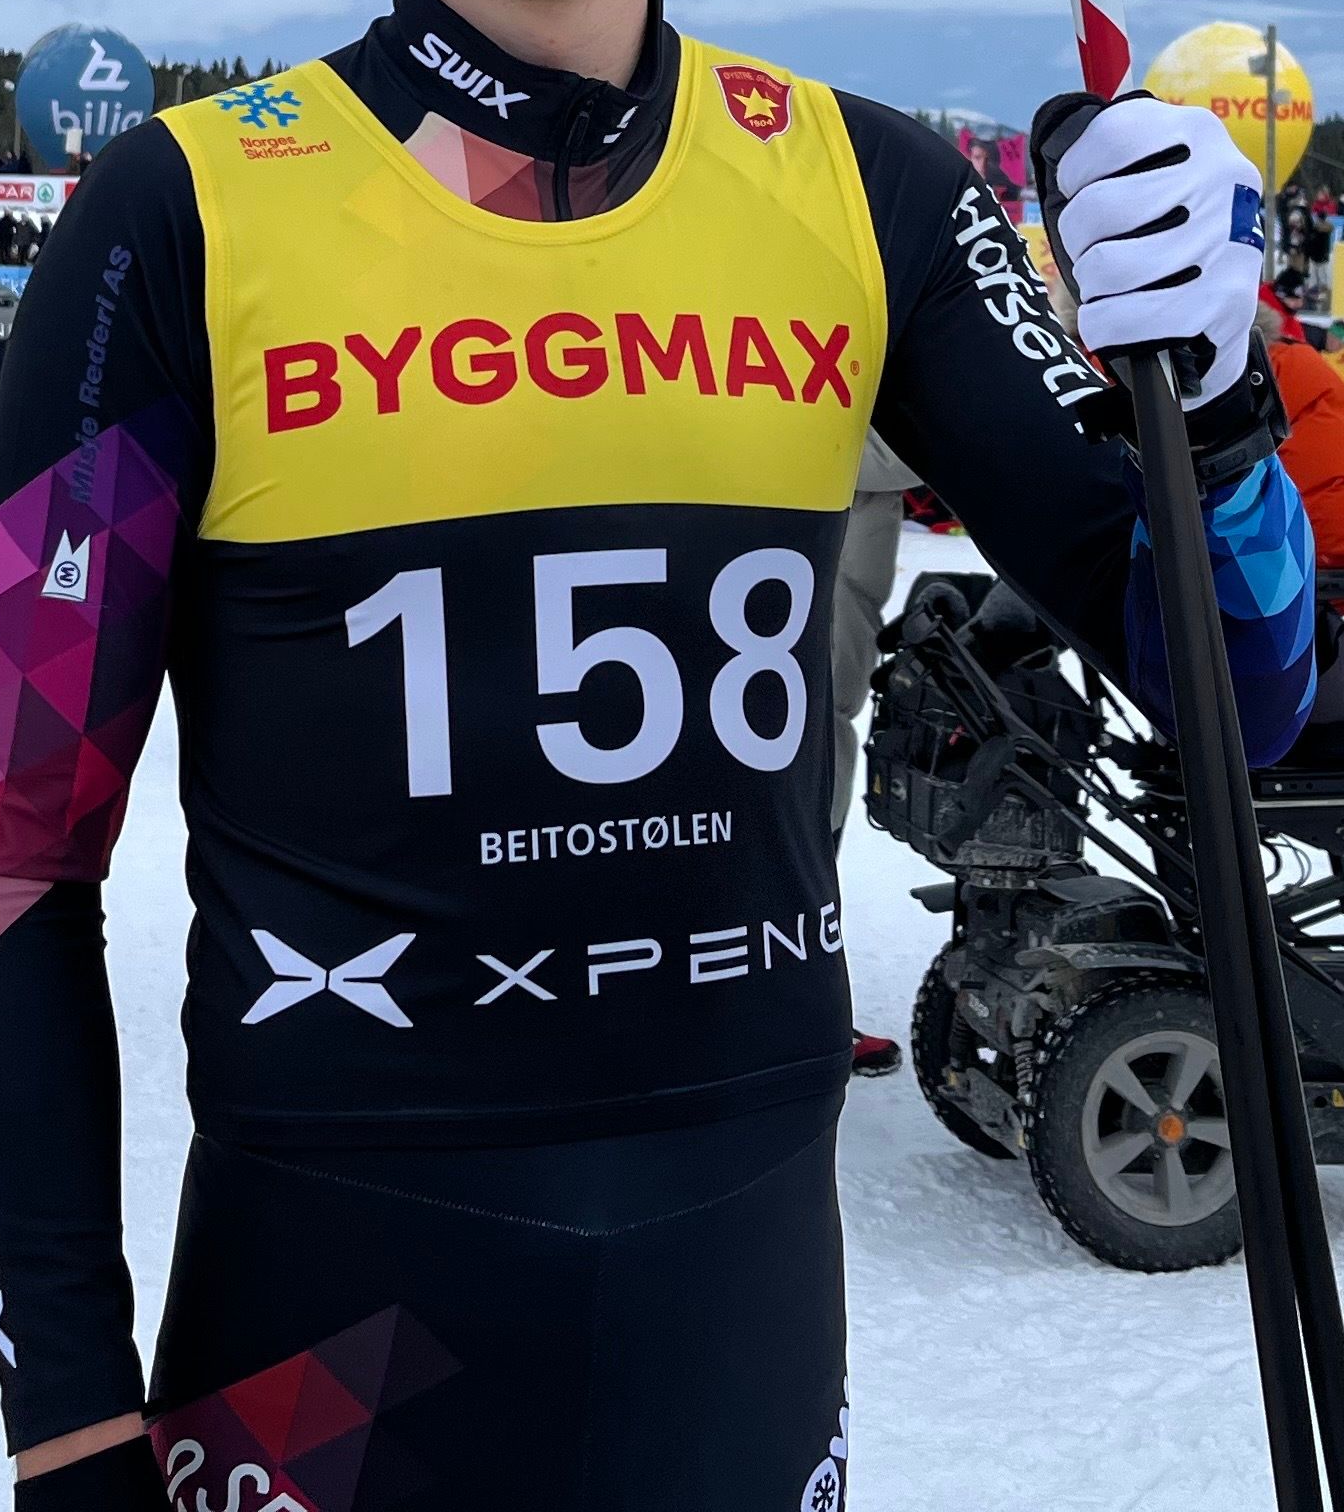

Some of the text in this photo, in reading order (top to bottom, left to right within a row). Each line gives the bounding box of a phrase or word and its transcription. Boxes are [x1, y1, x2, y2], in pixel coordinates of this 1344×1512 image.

[408, 32, 531, 120] SWIX
[51, 99, 143, 136] bilia
[239, 135, 297, 150] Norges
[244, 140, 332, 160] Skiforbund
[79, 293, 116, 409] Rederi
[102, 245, 132, 297] AS
[343, 547, 816, 798] 158
[480, 810, 733, 866] BEITOSTØLEN
[473, 900, 843, 1006] XPENG
